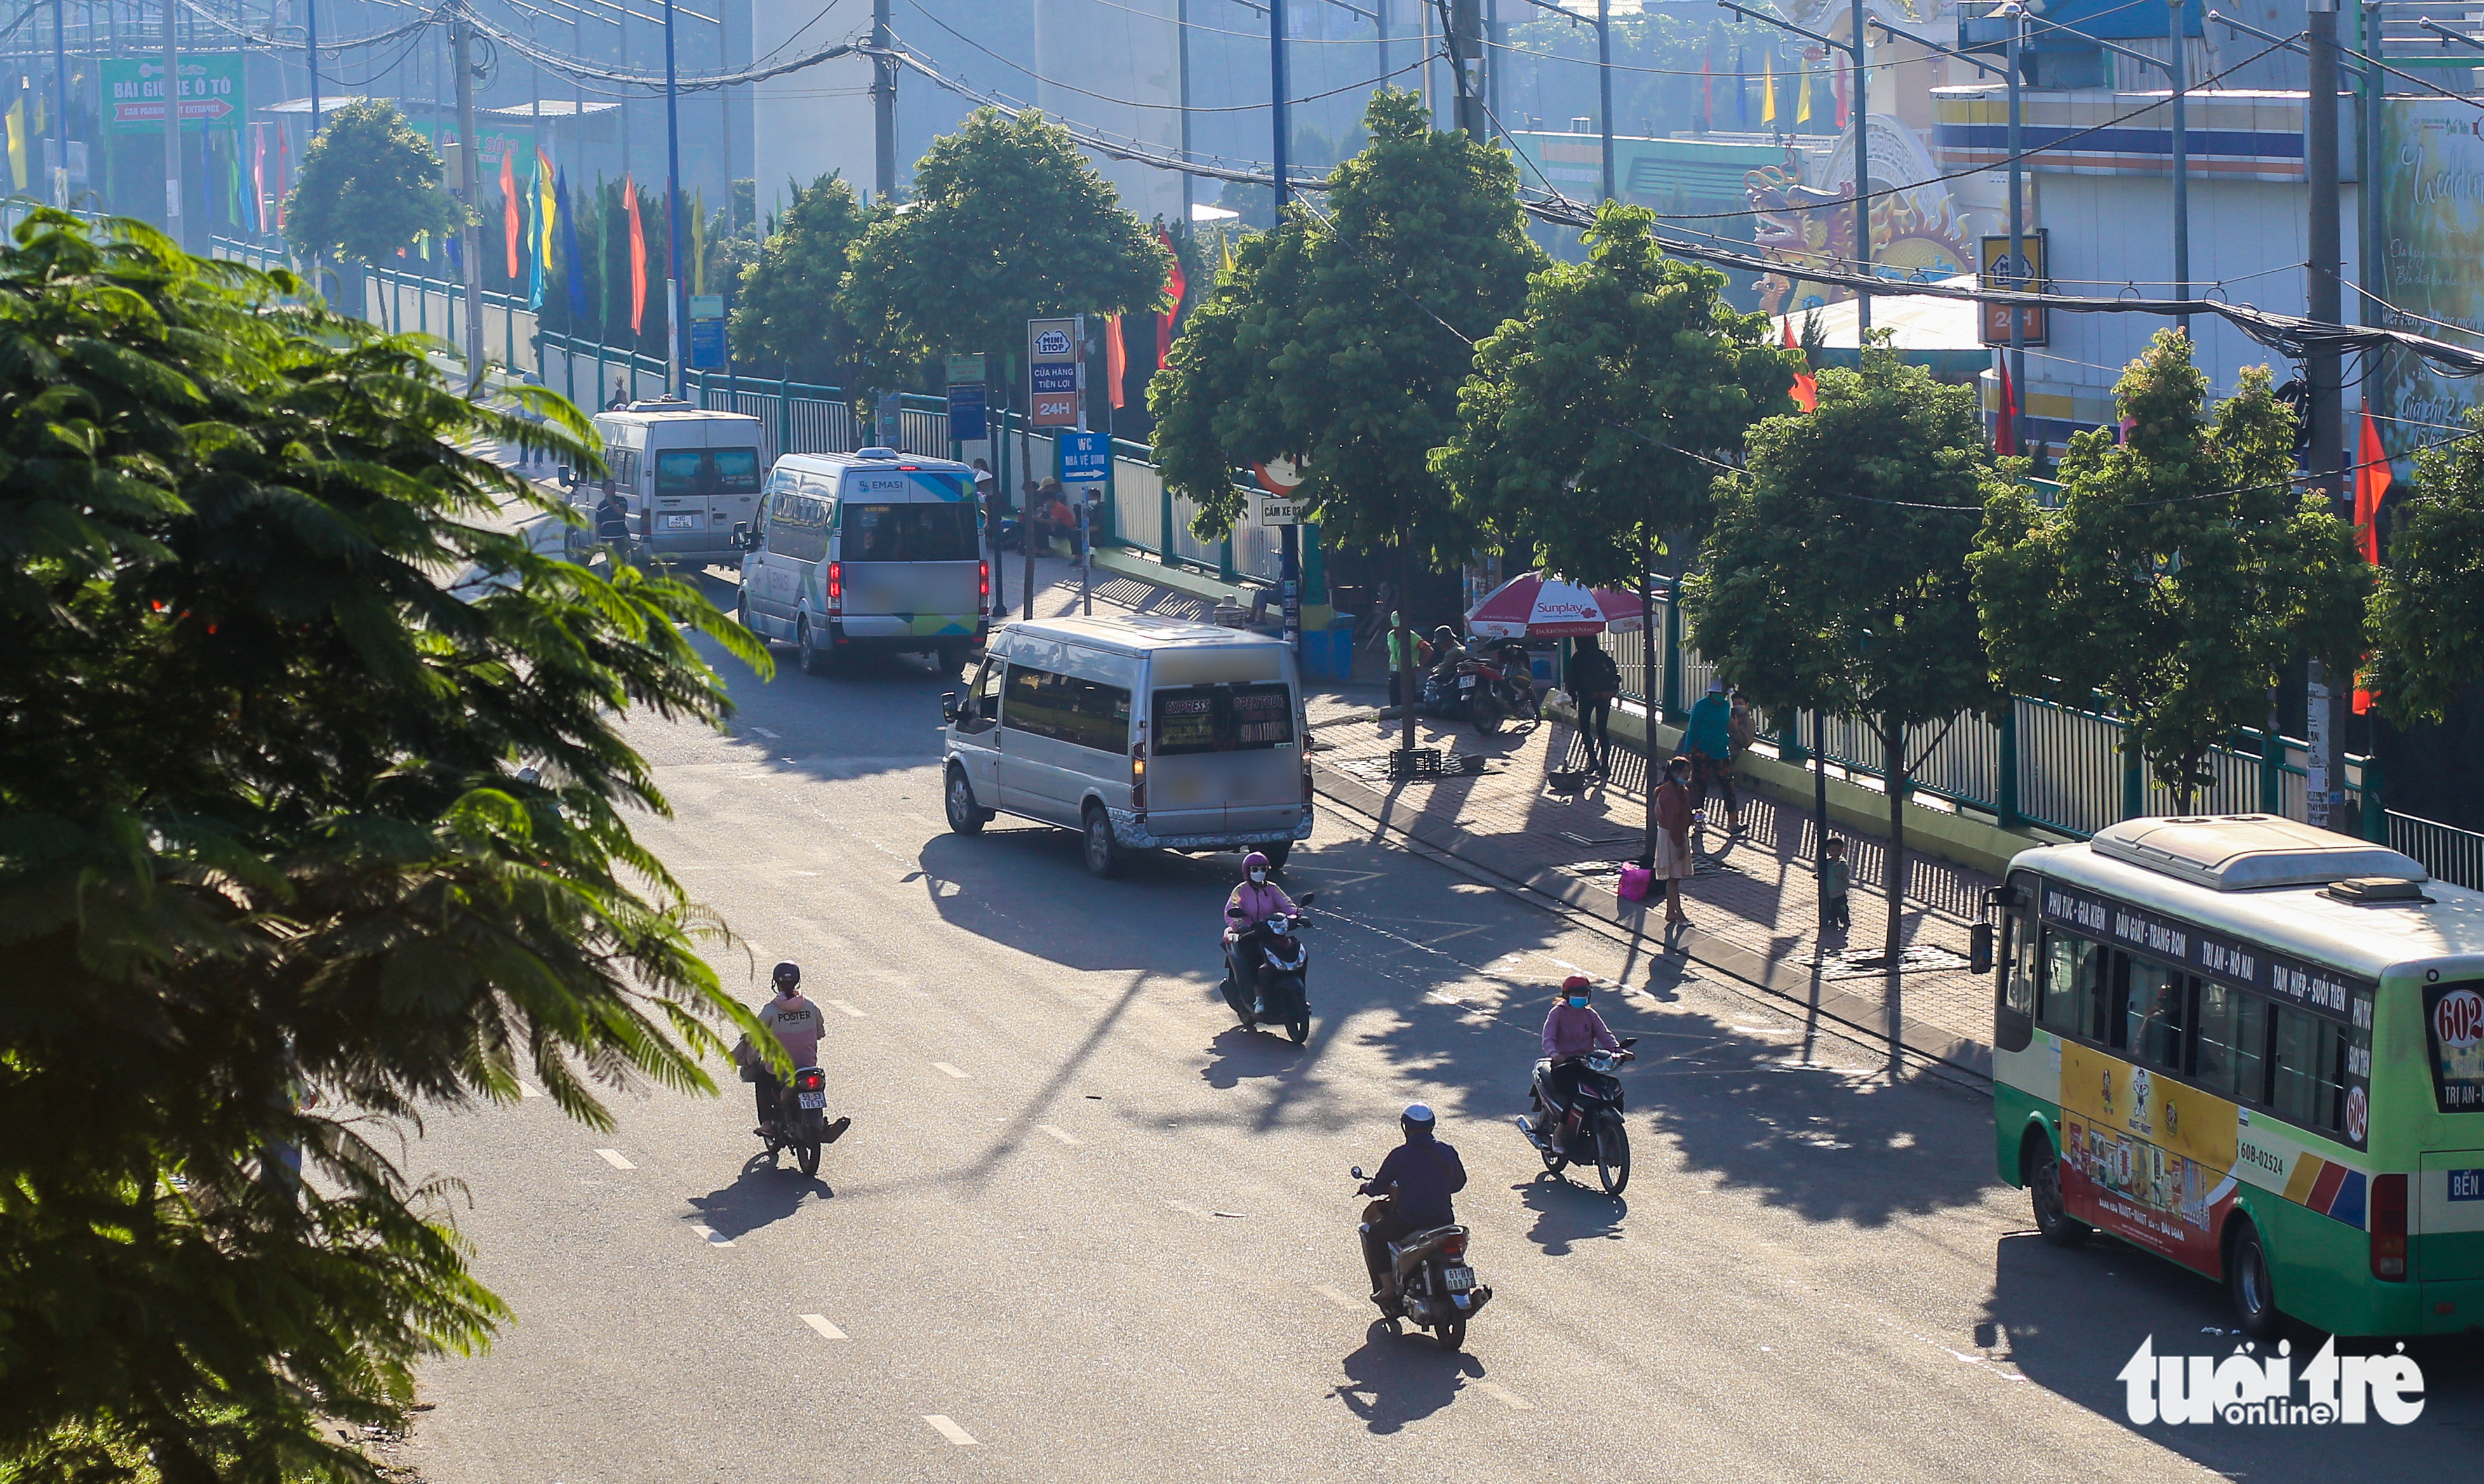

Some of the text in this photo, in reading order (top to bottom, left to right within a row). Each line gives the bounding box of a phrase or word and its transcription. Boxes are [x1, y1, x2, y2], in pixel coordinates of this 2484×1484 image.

[114, 80, 138, 98] BÃI
[195, 77, 206, 96] Ô
[210, 76, 232, 95] TÔ
[124, 107, 138, 116] CAR
[140, 106, 166, 116] PARKIN
[185, 104, 220, 114] ENTRANCE
[486, 133, 504, 154] SỐ
[509, 139, 518, 155] 3
[1043, 336, 1063, 344] MINI
[1042, 344, 1064, 352] STOP
[1034, 366, 1074, 377] CỬA HÀNG
[1038, 379, 1071, 389] TIỆN LỢI
[1039, 402, 1070, 416] 24H
[2401, 392, 2422, 419] Giá
[1078, 437, 1092, 451] WC
[1065, 453, 1078, 466] NHÀ
[1079, 454, 1088, 467] VỆ
[872, 480, 903, 489] EMASI
[1264, 504, 1281, 517] CẤM
[1281, 505, 1291, 517] XE
[1537, 602, 1583, 615] Sunplay
[1165, 699, 1210, 714] EXPRESS
[2048, 888, 2062, 916] PHÚ
[2062, 891, 2074, 921] TÚC
[2078, 900, 2089, 926] GIA
[2090, 900, 2106, 935] KIỆM
[2170, 930, 2186, 958] BOM
[2202, 940, 2214, 973] TRỊ
[2214, 944, 2225, 971] AN
[2241, 954, 2254, 981] NAI
[2273, 964, 2288, 993] TAM
[2290, 966, 2307, 1003] HIỆP
[2330, 978, 2346, 1012] TIÊN
[778, 1010, 811, 1023] POSTER
[2438, 996, 2484, 1042] 602
[2445, 1085, 2460, 1107] TRỊ
[2462, 1086, 2475, 1104] AN
[2348, 1091, 2365, 1137] 602
[2241, 1142, 2283, 1177] 60B-02524
[2454, 1170, 2478, 1196] BẾN
[1448, 1278, 1473, 1288] 089.77
